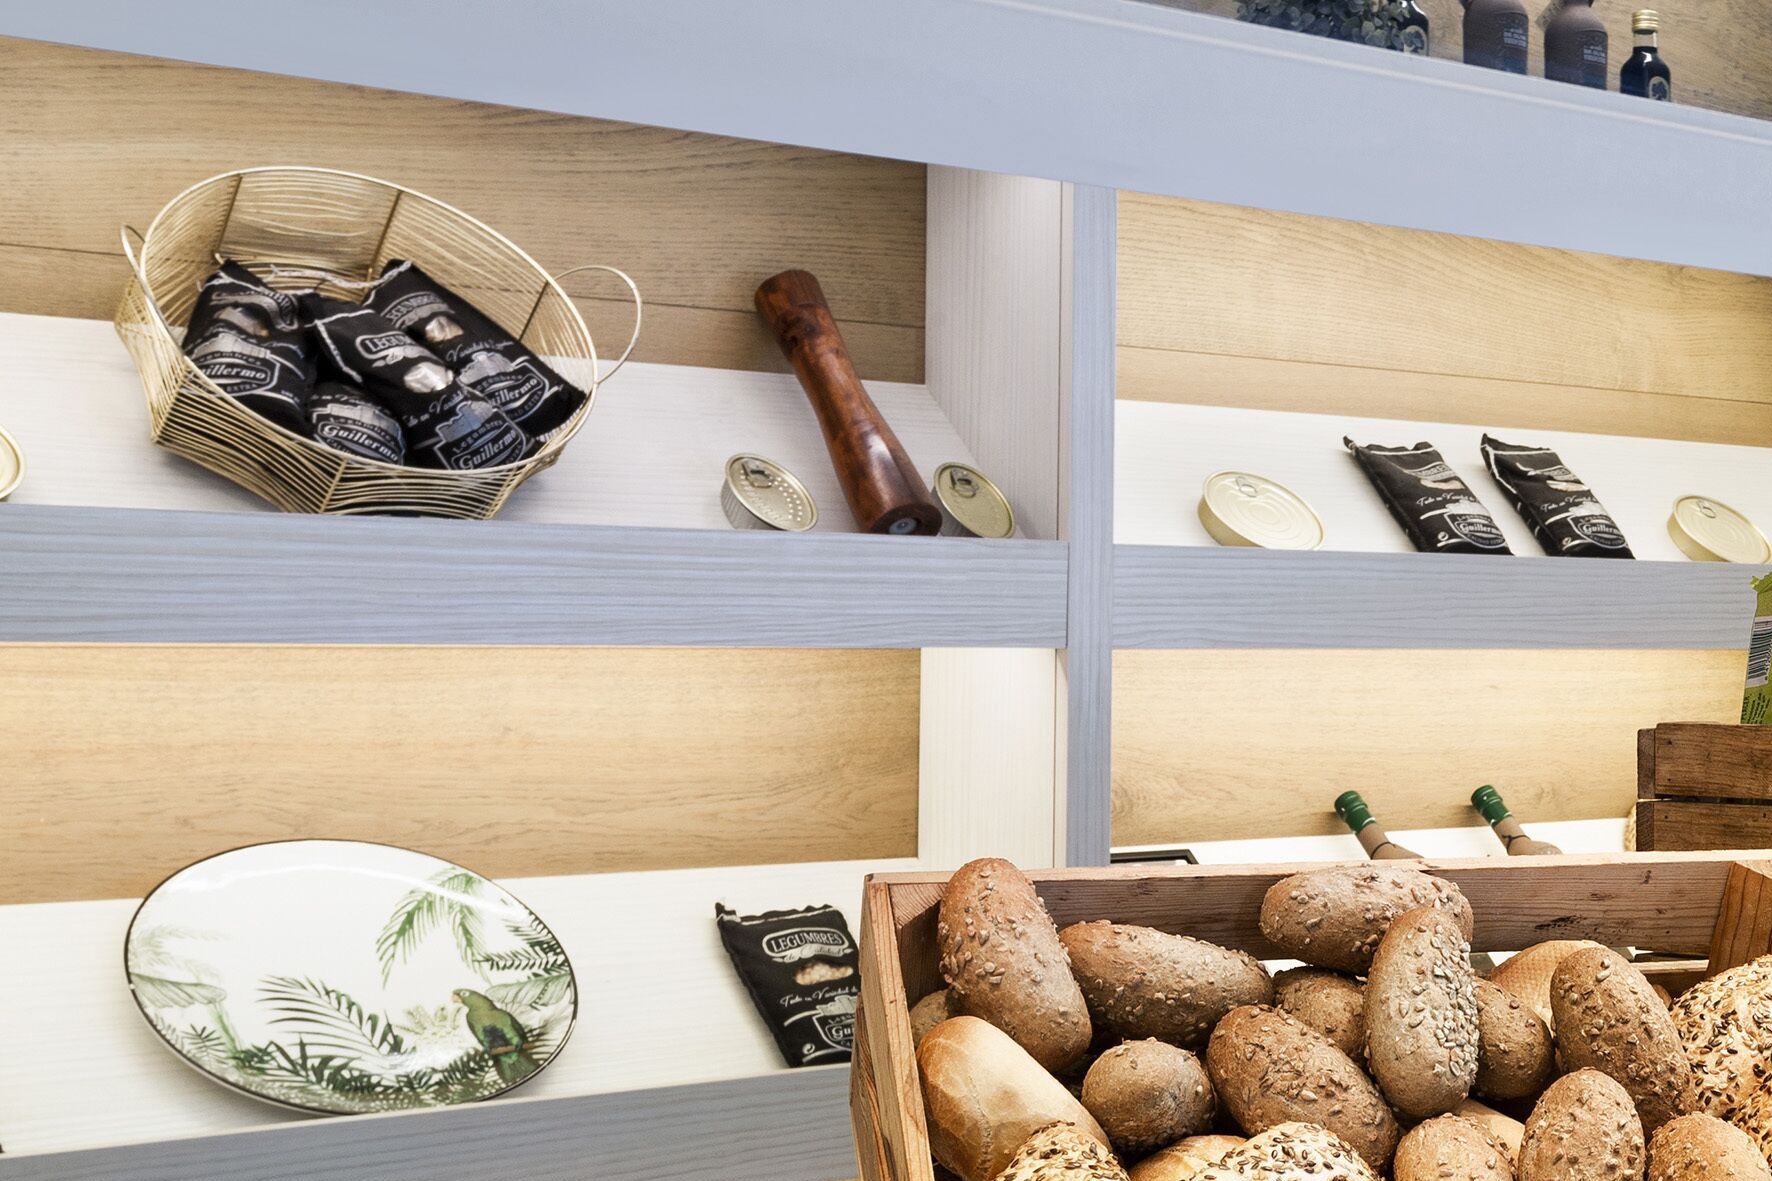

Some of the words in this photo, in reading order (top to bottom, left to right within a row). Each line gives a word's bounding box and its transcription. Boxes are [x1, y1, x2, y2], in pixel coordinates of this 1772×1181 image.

[201, 364, 267, 380] uillermo
[491, 377, 539, 405] uillermo
[322, 423, 399, 462] Guillermo
[458, 428, 518, 469] Guillermo
[1582, 523, 1622, 536] Guillerm
[770, 931, 843, 953] LEGUMBRES
